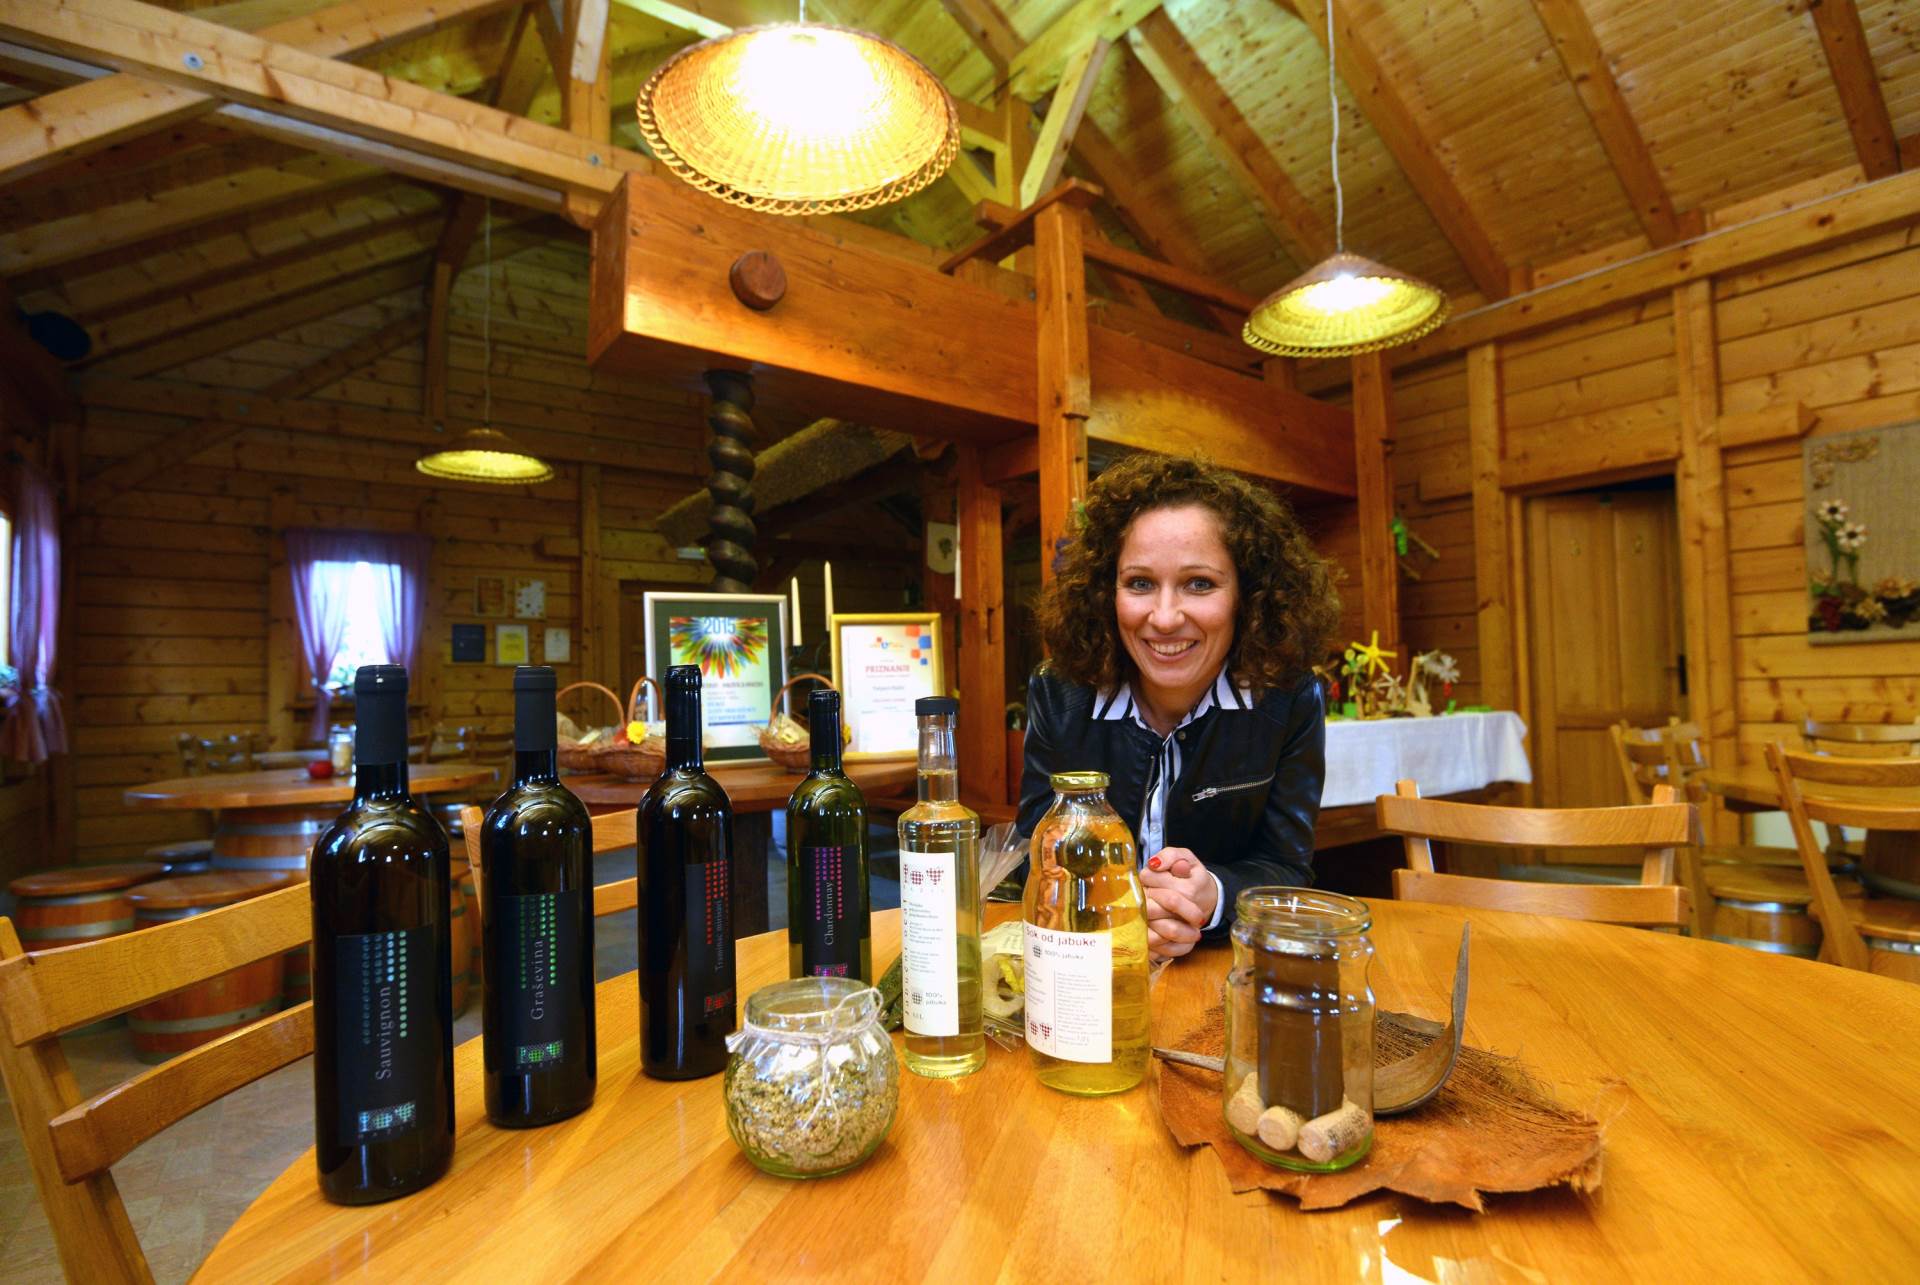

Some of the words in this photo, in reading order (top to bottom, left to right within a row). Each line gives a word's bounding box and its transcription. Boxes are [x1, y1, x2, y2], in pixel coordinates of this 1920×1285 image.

[703, 617, 736, 635] 2015
[823, 881, 834, 946] Chardonnay
[1041, 934, 1054, 943] od
[1058, 937, 1096, 947] jabuke
[530, 940, 545, 1021] Graševina
[375, 986, 394, 1080] Sauvignon
